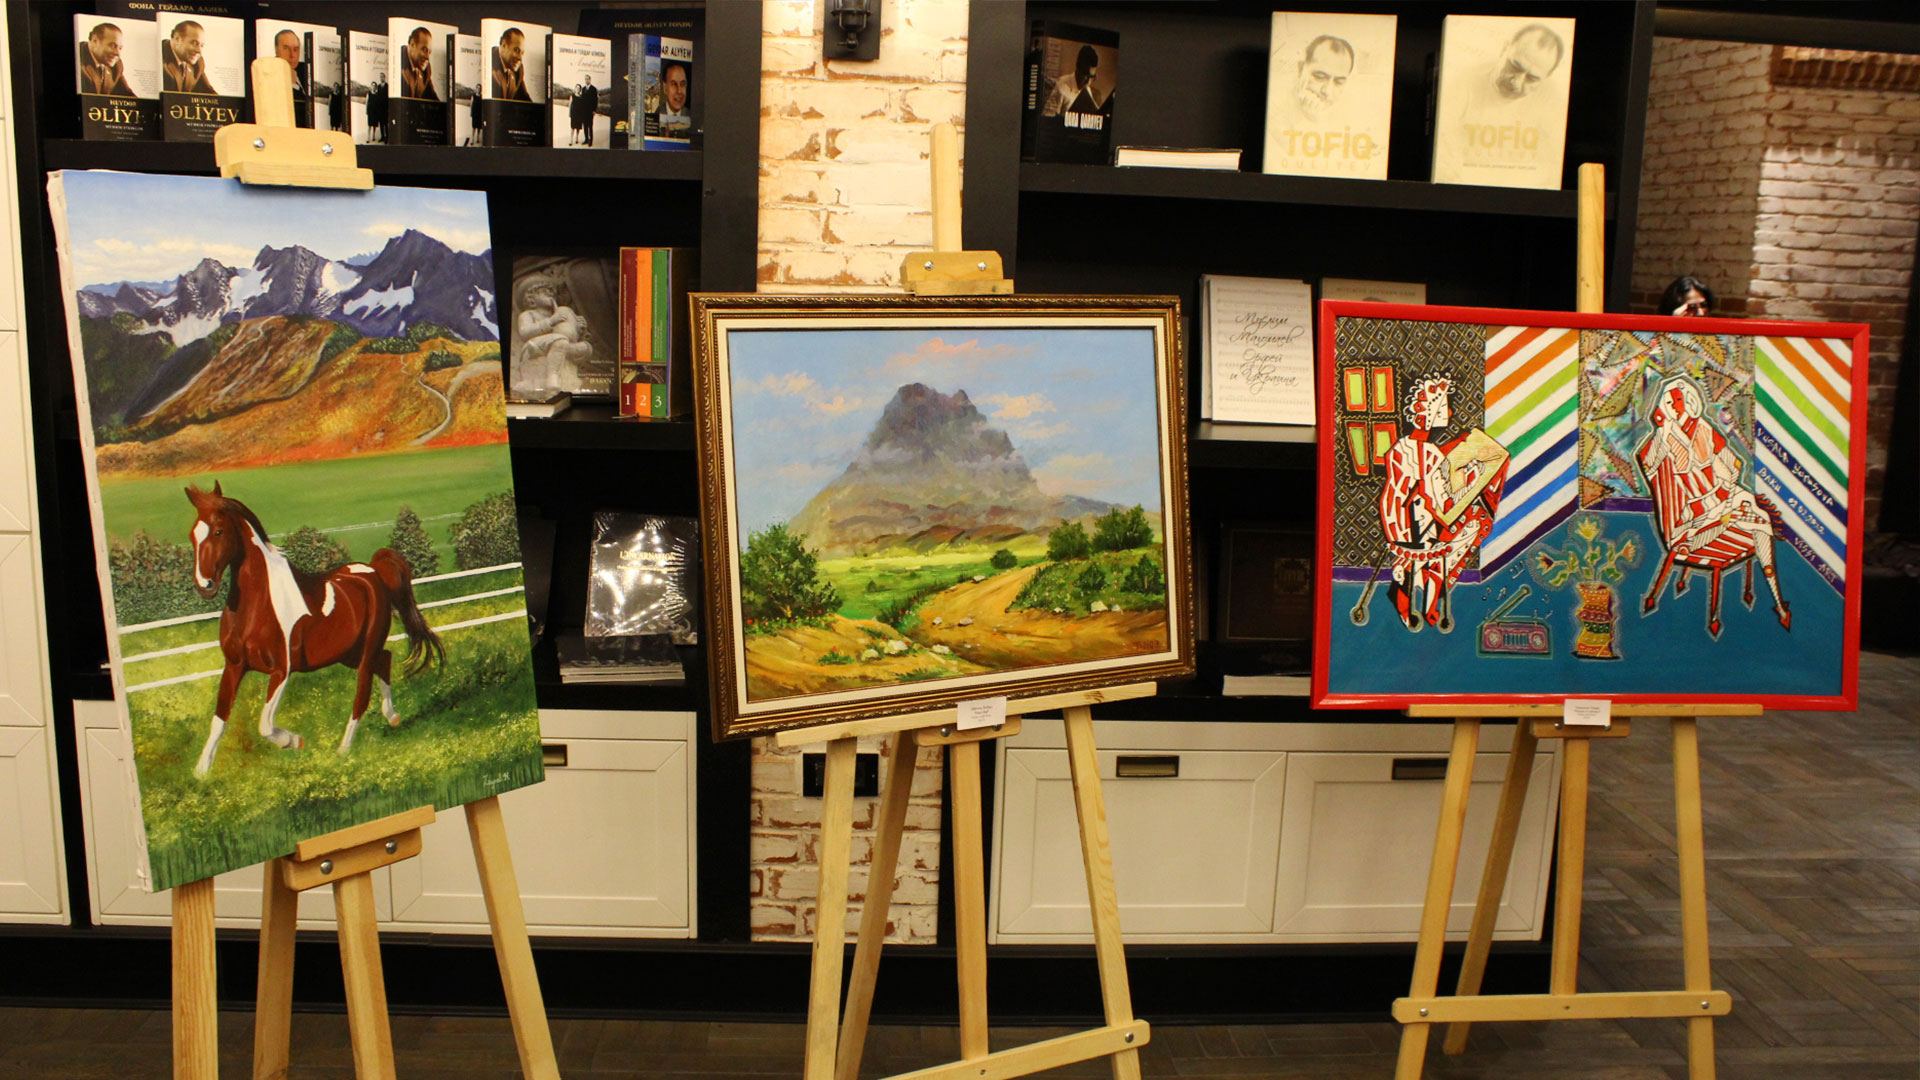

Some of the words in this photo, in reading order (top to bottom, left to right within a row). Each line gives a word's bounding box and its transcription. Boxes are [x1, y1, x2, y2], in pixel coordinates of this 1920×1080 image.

[625, 394, 631, 406] 1
[640, 394, 647, 407] 2
[654, 395, 662, 408] 3
